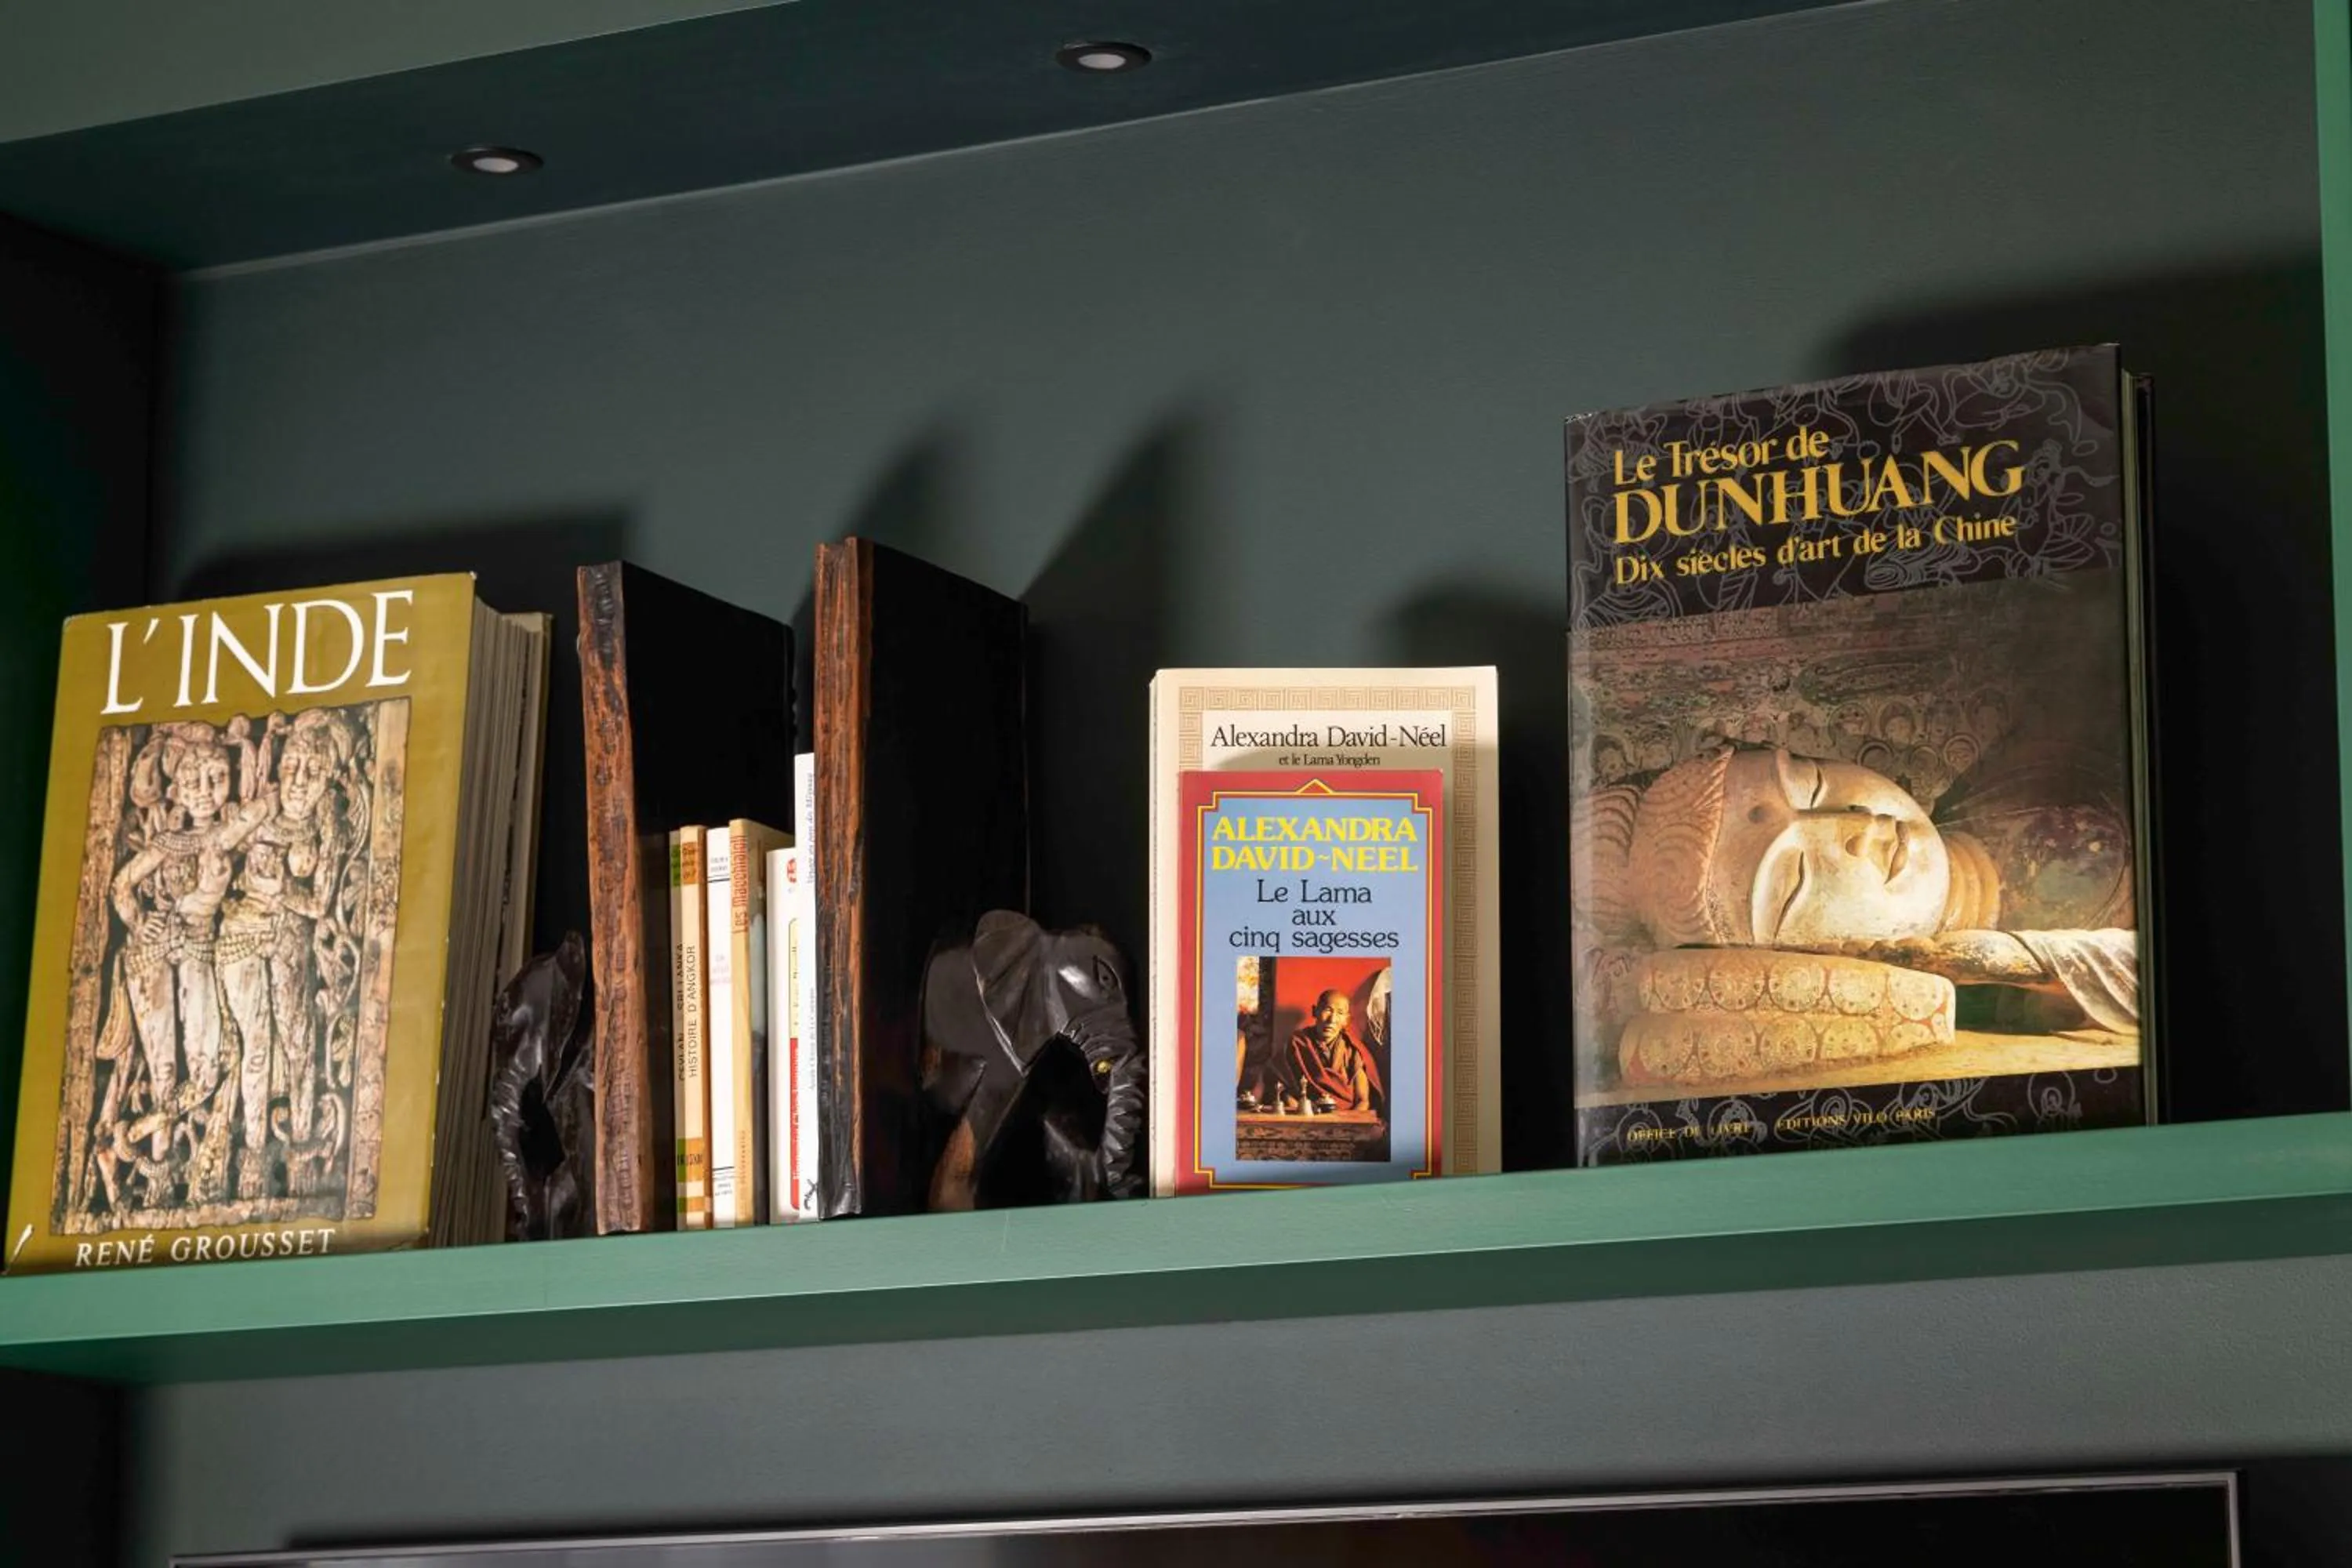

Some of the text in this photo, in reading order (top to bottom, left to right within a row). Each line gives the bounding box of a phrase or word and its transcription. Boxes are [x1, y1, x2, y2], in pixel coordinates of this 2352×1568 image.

[1615, 426, 1830, 485] Le Trésor de
[1613, 440, 2026, 544] DUNHUANG
[1616, 512, 2017, 586] Dix siècles d'art de la Chine
[100, 588, 416, 716] L'INDE
[1210, 724, 1319, 747] Alexandra
[1279, 754, 1381, 768] et le Lama Yongden
[1211, 816, 1418, 842] ALEXANDRA
[1257, 879, 1373, 903] Le Lama
[1291, 908, 1337, 927] aux
[1229, 927, 1399, 953] cinq sagesses
[686, 945, 698, 1078] HISTOIRE D'ANGKOR
[75, 1229, 336, 1267] RENÉ GROUSSET
